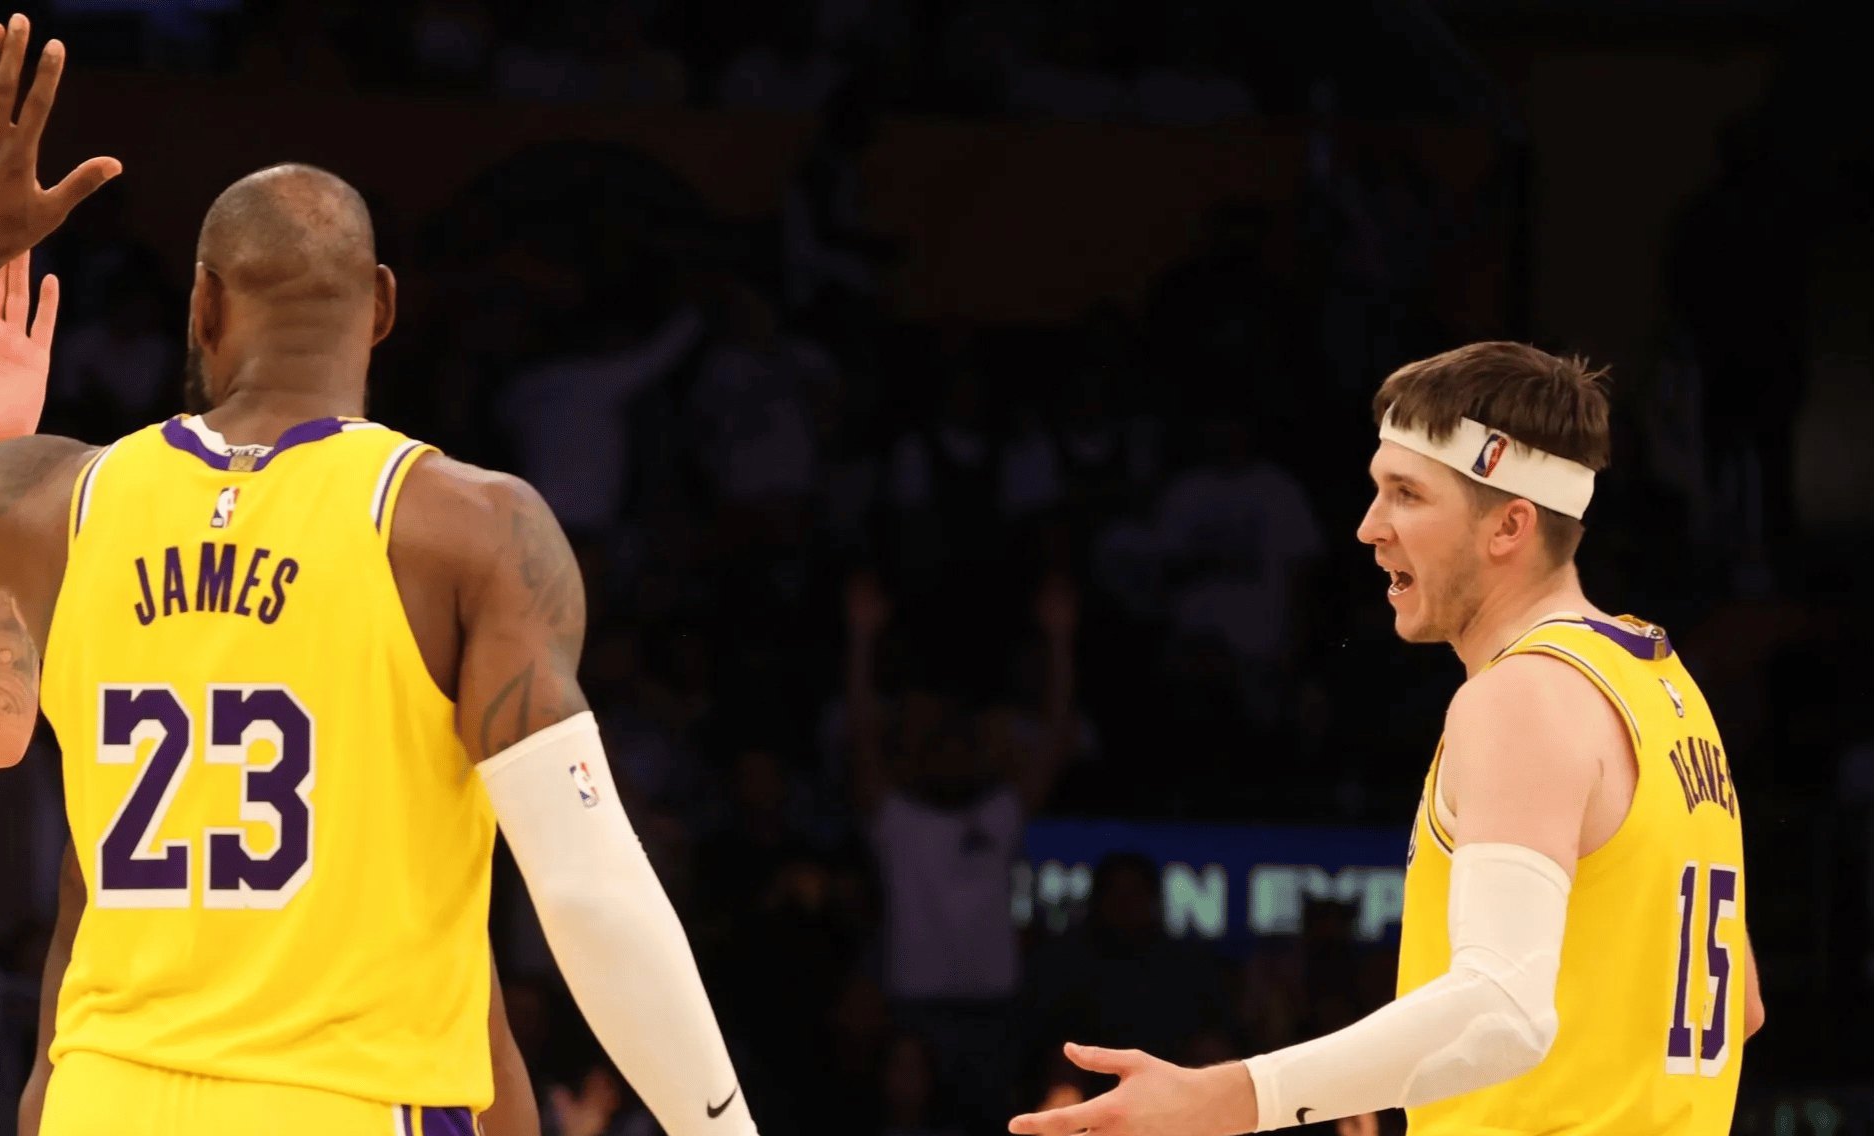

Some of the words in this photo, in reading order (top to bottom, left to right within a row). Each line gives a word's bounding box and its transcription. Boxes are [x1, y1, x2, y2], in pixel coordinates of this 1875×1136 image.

[133, 541, 299, 626] JAMES
[95, 682, 316, 909] 23
[1664, 860, 1738, 1077] 15
